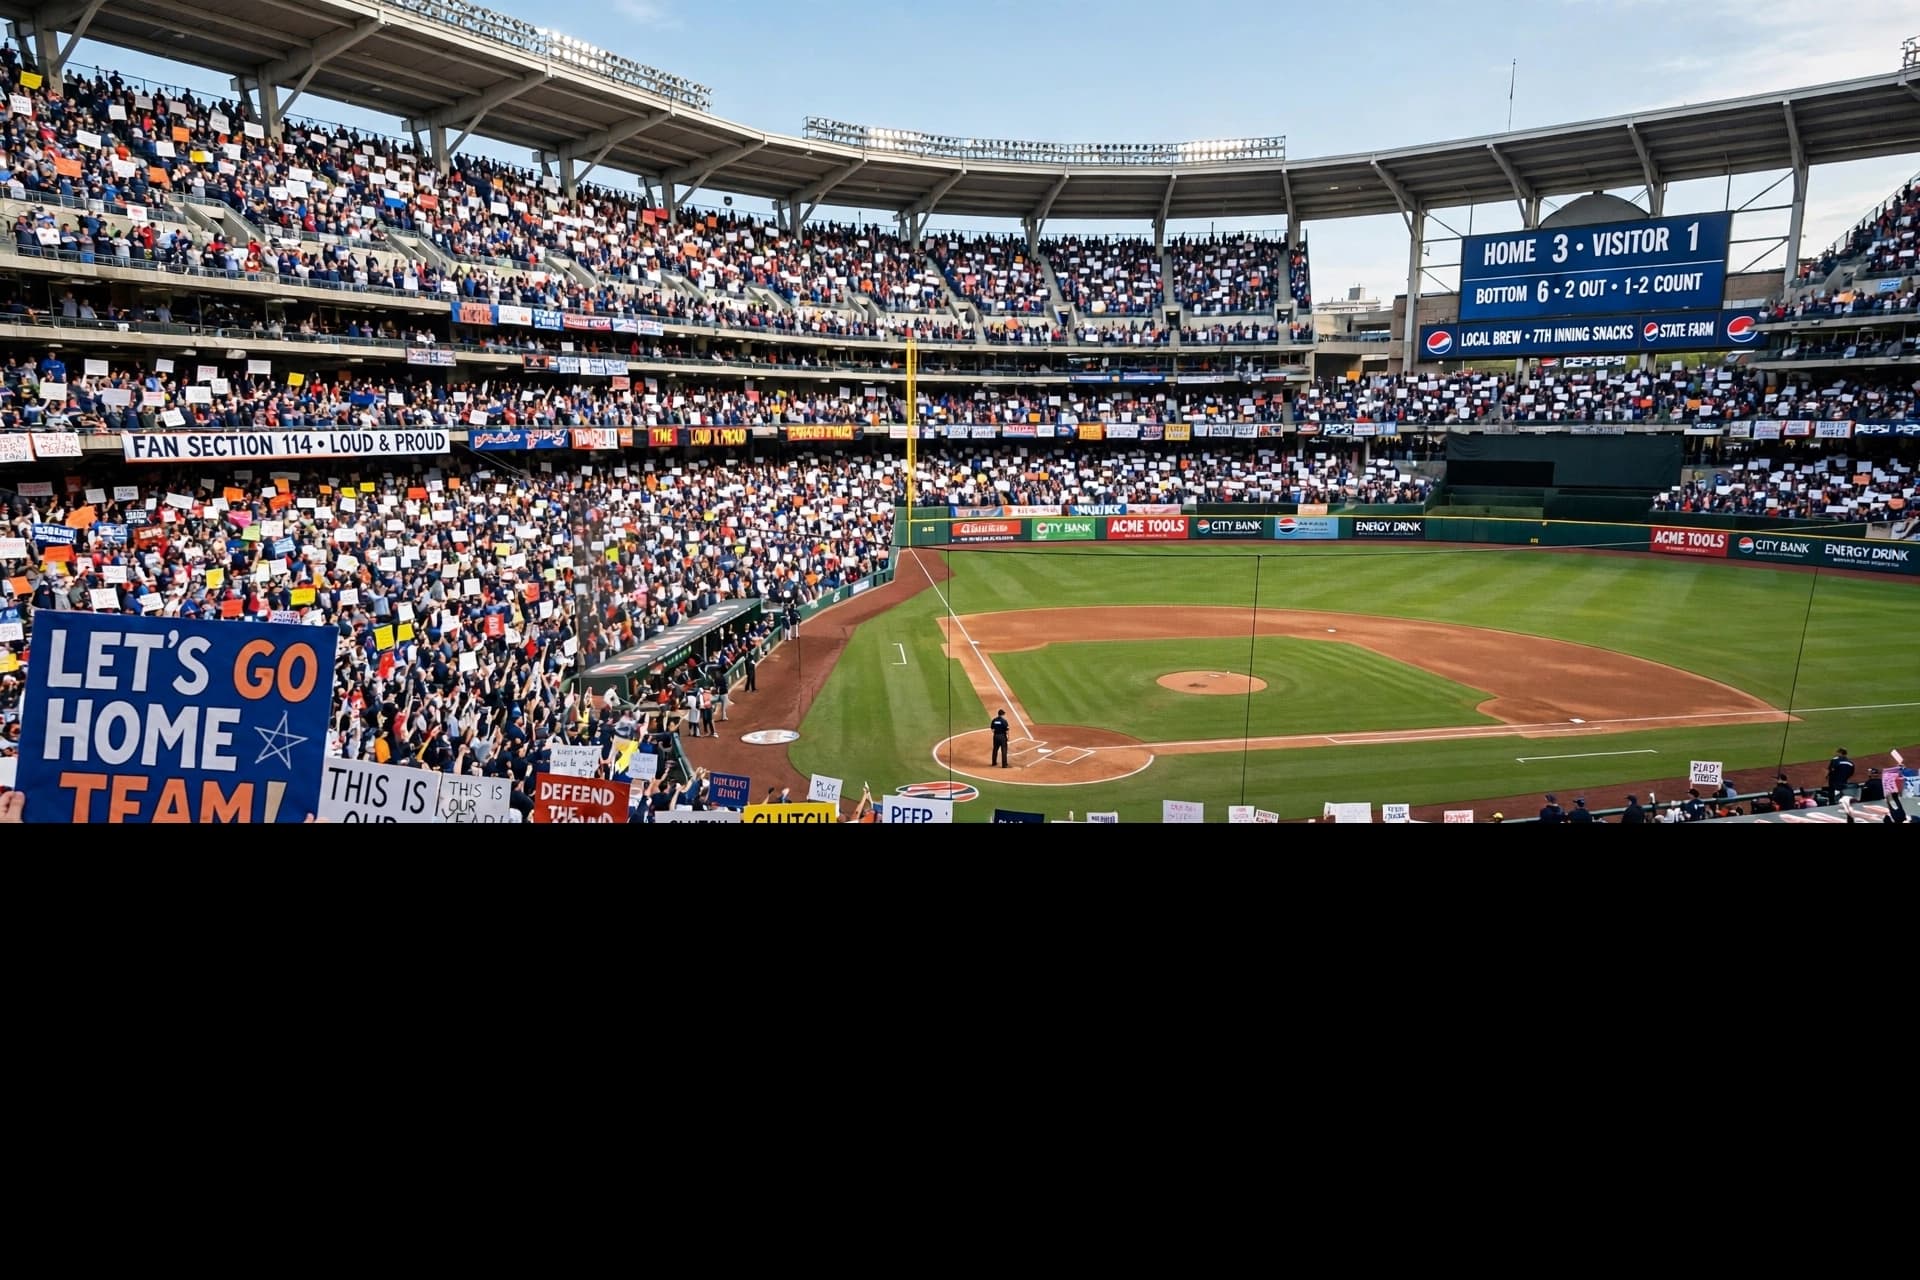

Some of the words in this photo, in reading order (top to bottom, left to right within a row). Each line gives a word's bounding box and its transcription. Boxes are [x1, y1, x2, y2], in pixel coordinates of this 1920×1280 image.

[1484, 239, 1536, 265] HOME
[1552, 234, 1568, 263] 3
[1593, 227, 1670, 256] VISITOR
[1688, 222, 1699, 251] 1
[1476, 285, 1527, 304] BOTTOM
[1537, 280, 1549, 303] 6
[1565, 280, 1575, 298] 2
[1579, 279, 1607, 297] OUT
[1625, 276, 1648, 294] 1-2
[1654, 272, 1703, 292] COUNT
[1461, 331, 1490, 347] LOCAL
[1493, 330, 1522, 345] BREW
[1533, 328, 1551, 343] 7TH
[1555, 327, 1589, 342] INNING
[1592, 325, 1633, 340] SNACKS
[1660, 323, 1686, 338] STATE
[1688, 321, 1714, 336] FARM
[133, 435, 179, 458] FAN
[187, 435, 273, 457] SECTION
[282, 434, 312, 454] 114
[330, 433, 373, 453] LOUD
[379, 434, 391, 451] &
[395, 432, 445, 451] PROUD
[1064, 522, 1092, 533] BANK
[1111, 519, 1144, 533] ACME
[1148, 519, 1185, 532] TOOLS
[1211, 520, 1233, 531] CITY
[1236, 520, 1262, 530] BANK
[1654, 530, 1684, 545] ACME
[1687, 532, 1724, 548] TOOLS
[1755, 539, 1779, 551] CITY
[1780, 541, 1810, 554] BANK
[1825, 543, 1870, 558] ENERGY
[1871, 548, 1910, 561] DRINK
[47, 629, 211, 696] LET'S
[233, 639, 319, 703] GO
[43, 698, 241, 772] HOME
[328, 767, 389, 808] THIS
[402, 779, 427, 814] IS
[448, 781, 482, 798] THIS
[491, 784, 502, 800] IS
[449, 798, 476, 813] OUR
[548, 805, 578, 820] THE
